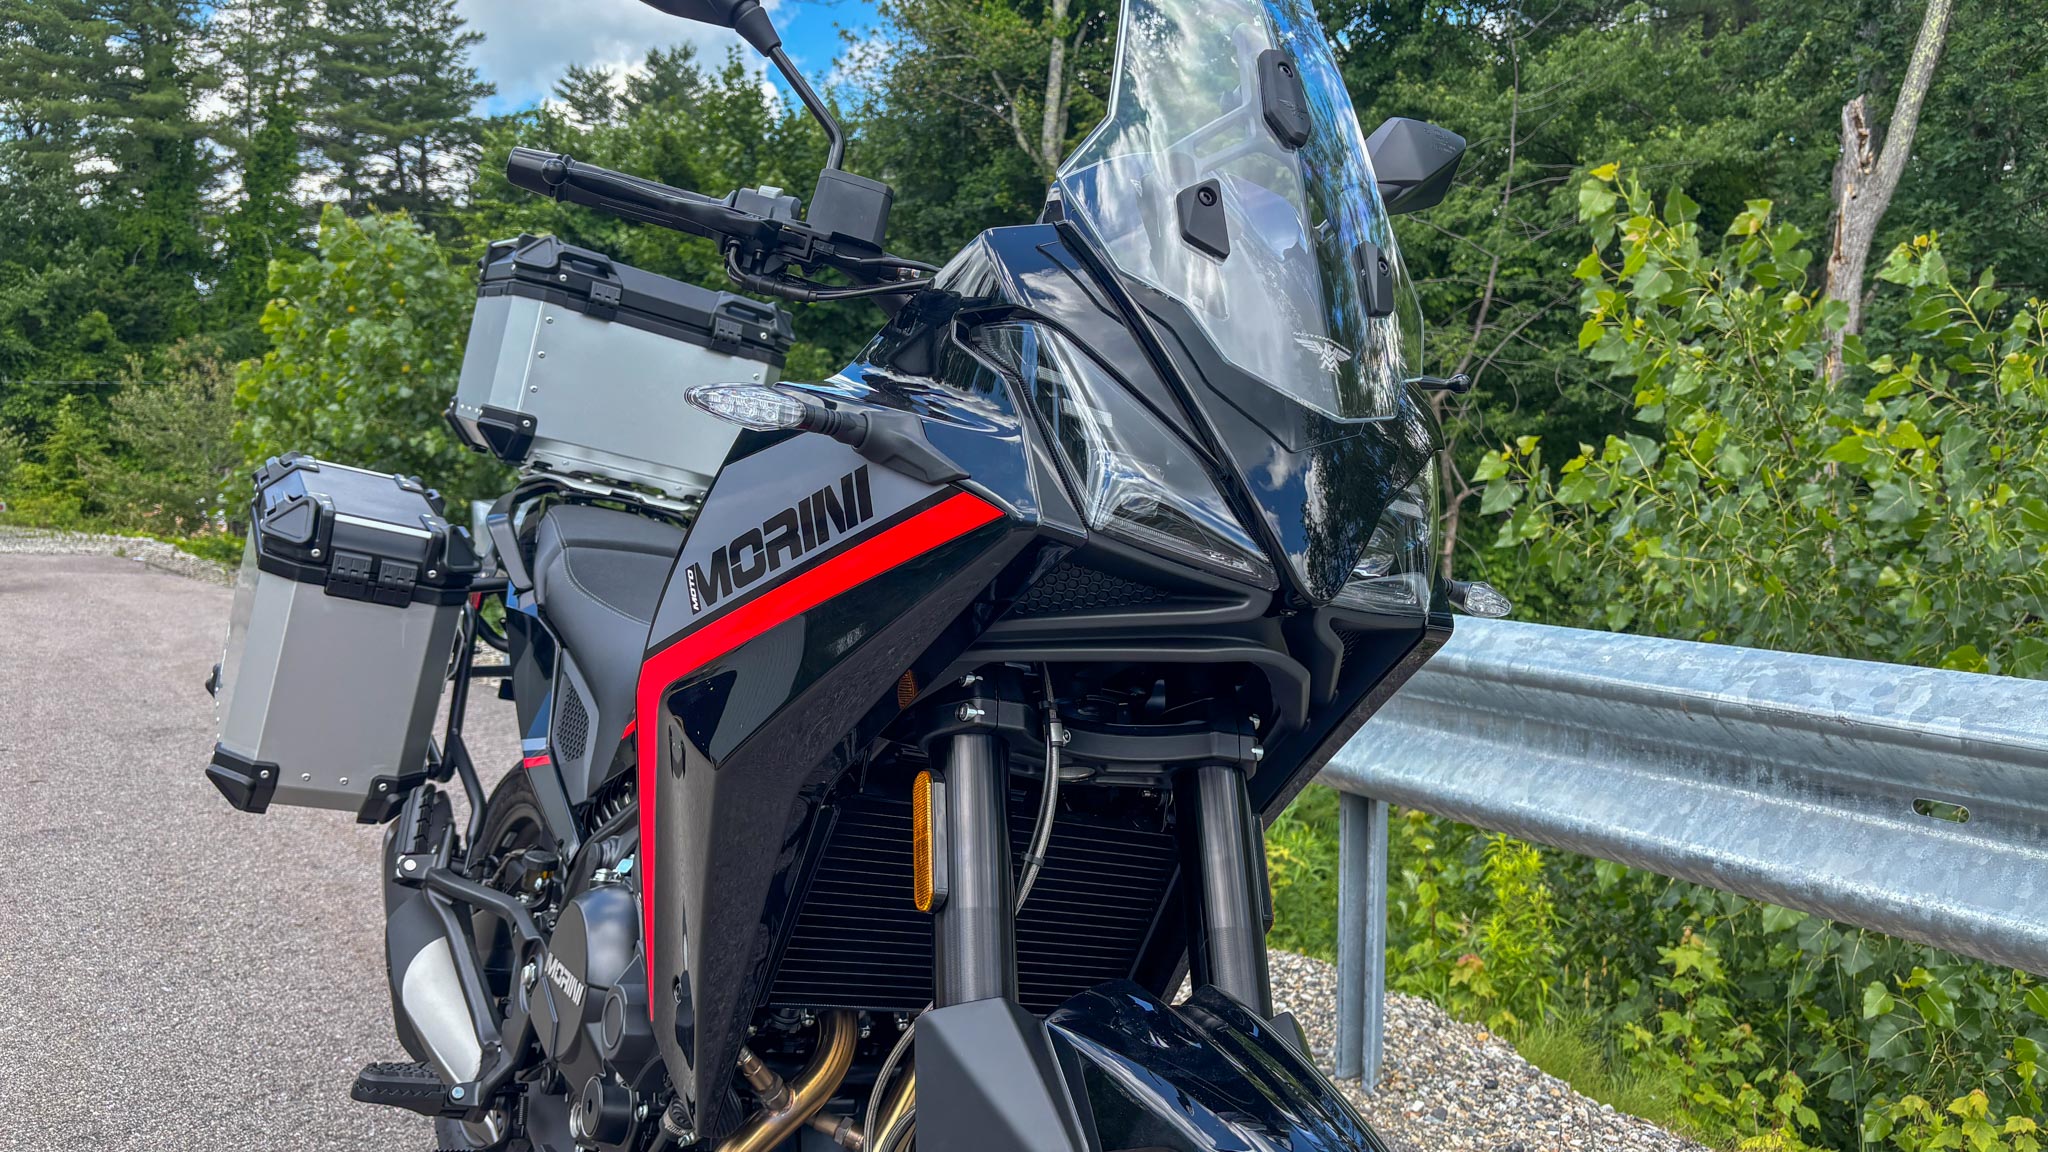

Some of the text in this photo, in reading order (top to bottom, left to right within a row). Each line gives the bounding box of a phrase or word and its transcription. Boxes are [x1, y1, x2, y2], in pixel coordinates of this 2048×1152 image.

[686, 464, 873, 611] MOTO MORINI
[544, 952, 586, 1006] MORINI
